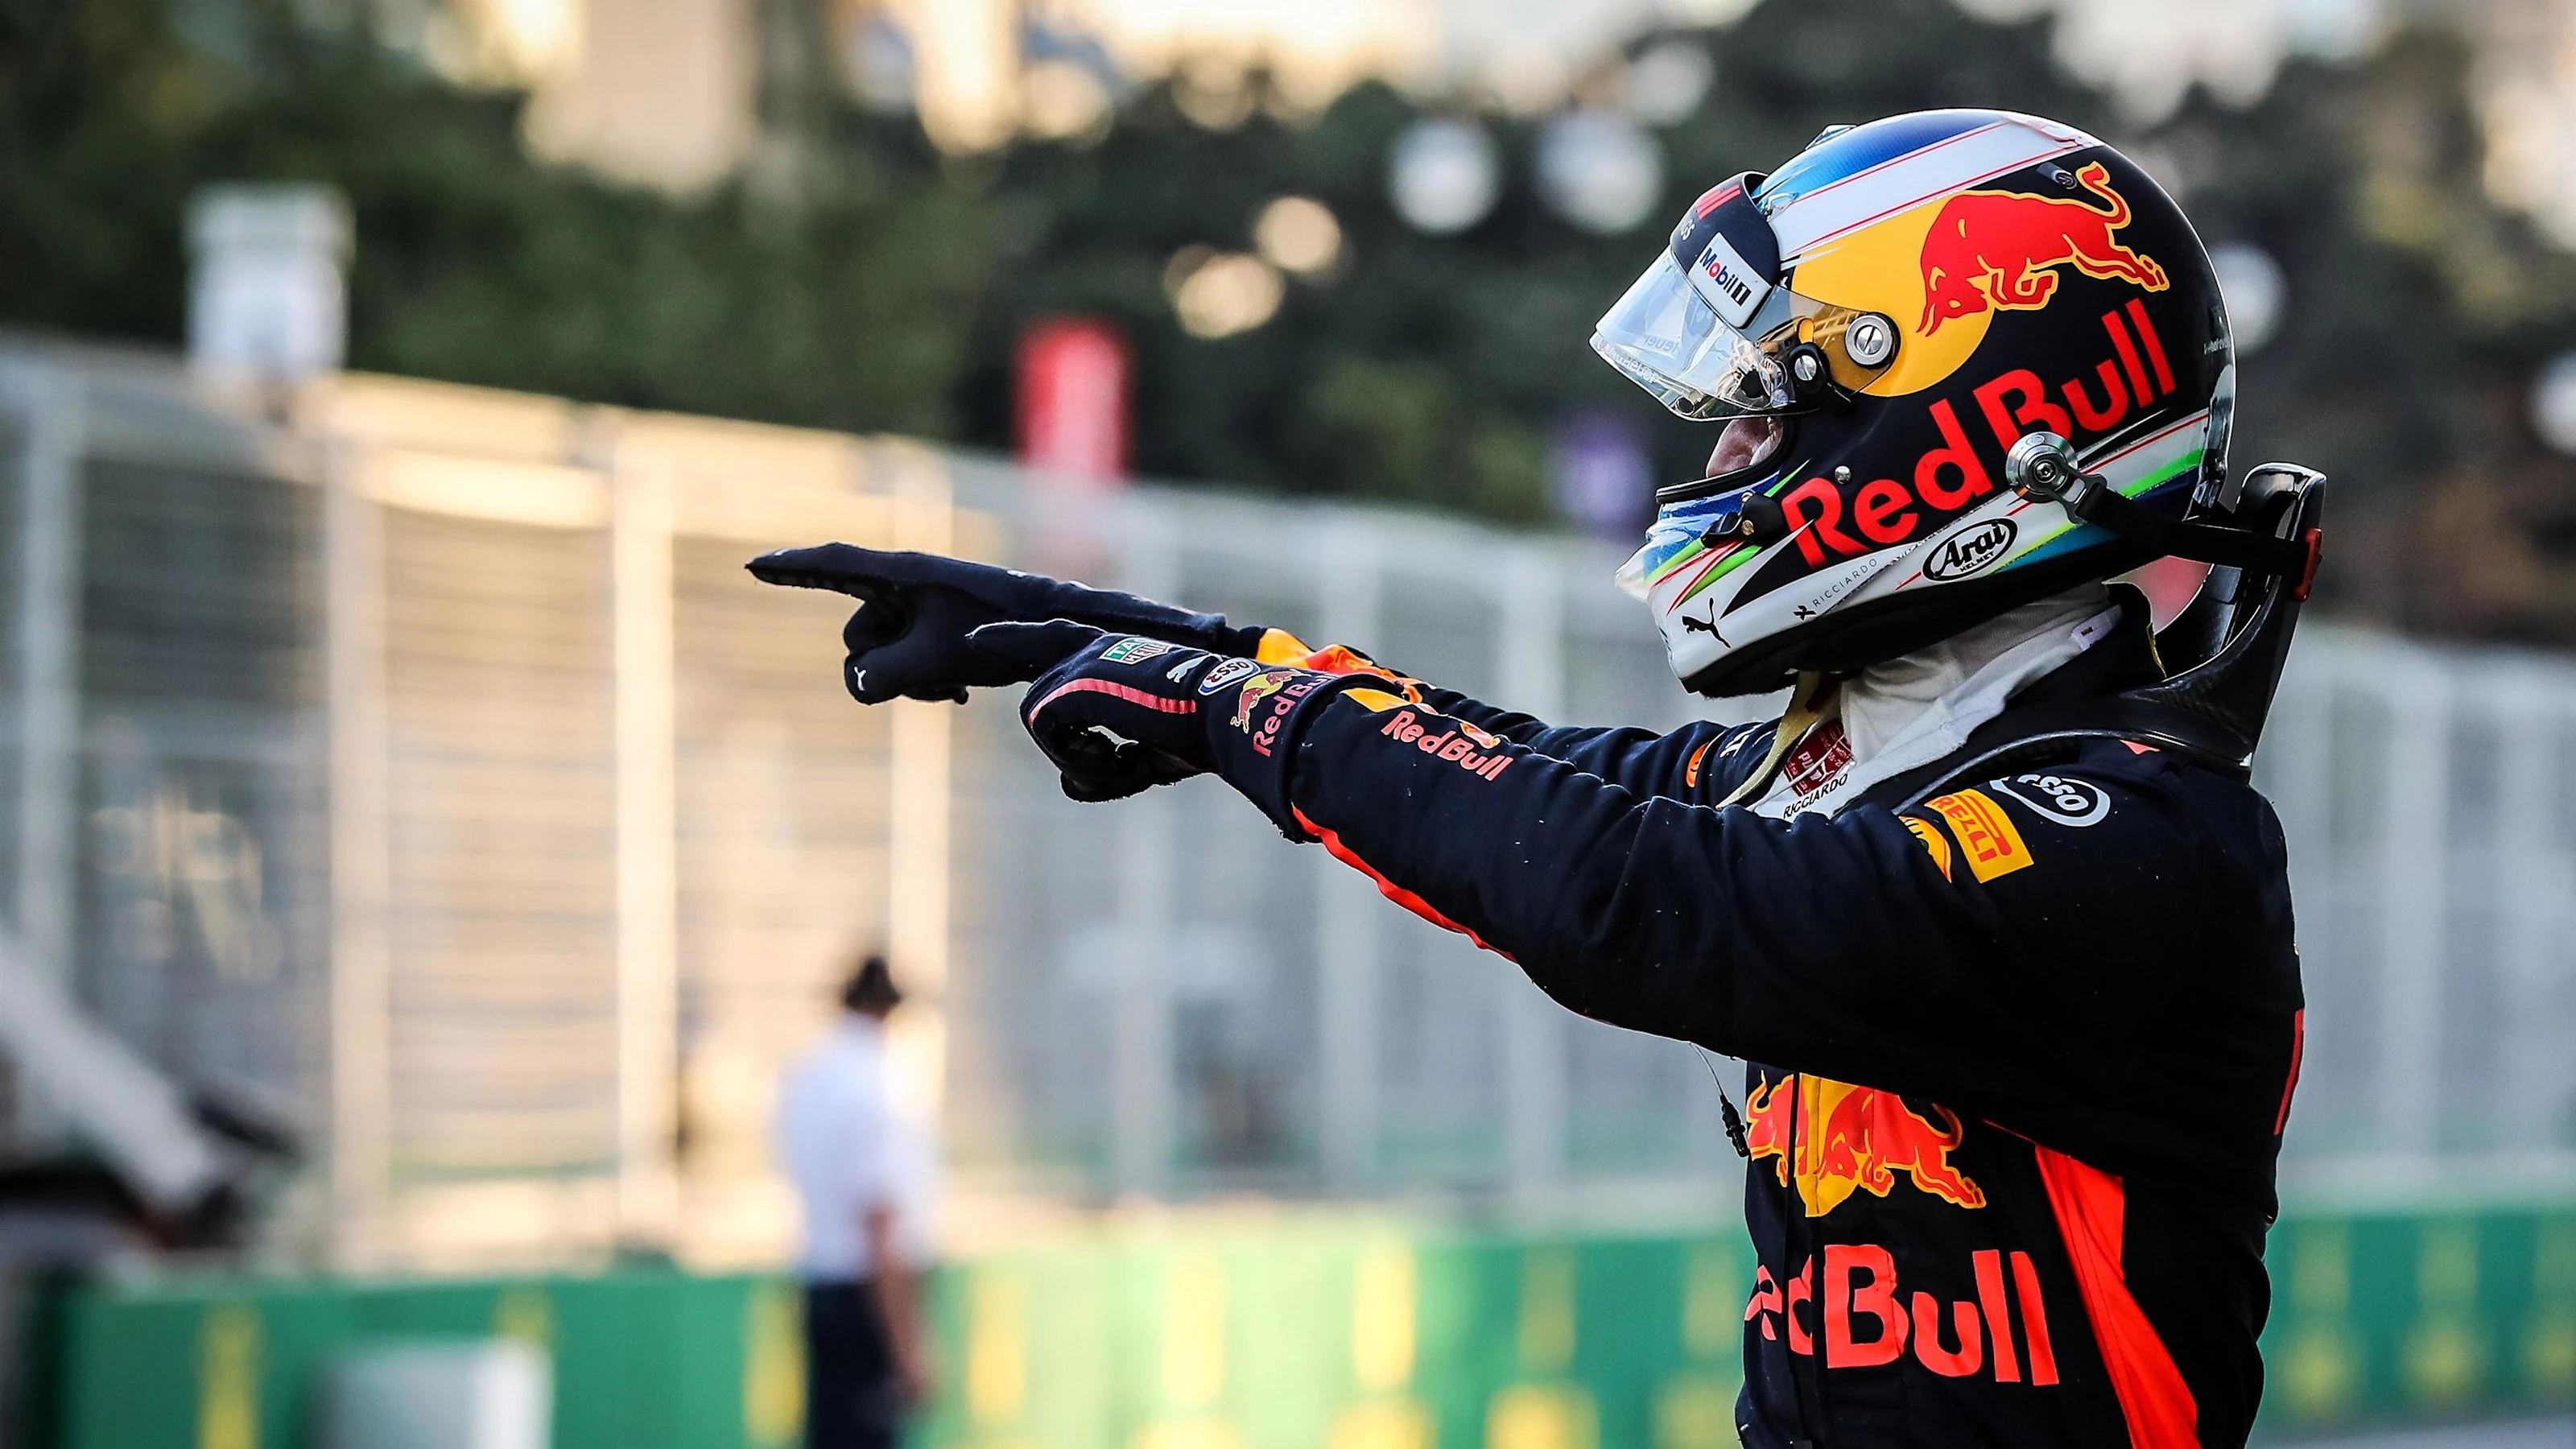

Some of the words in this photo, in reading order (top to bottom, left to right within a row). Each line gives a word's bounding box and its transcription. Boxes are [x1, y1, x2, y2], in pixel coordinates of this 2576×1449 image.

[1699, 247, 1737, 293] Mobil
[1781, 399, 1994, 568] Red
[1973, 298, 2175, 452] Bull
[1934, 520, 2008, 577] Arai
[1960, 551, 1995, 572] HELMET
[1812, 558, 1878, 608] RICCIARDO
[1253, 696, 1295, 758] Red
[1381, 709, 1456, 754] Red
[1437, 738, 1514, 782] Bull
[1783, 773, 1848, 819] RICCIARDO
[1824, 1244, 2059, 1386] Bull
